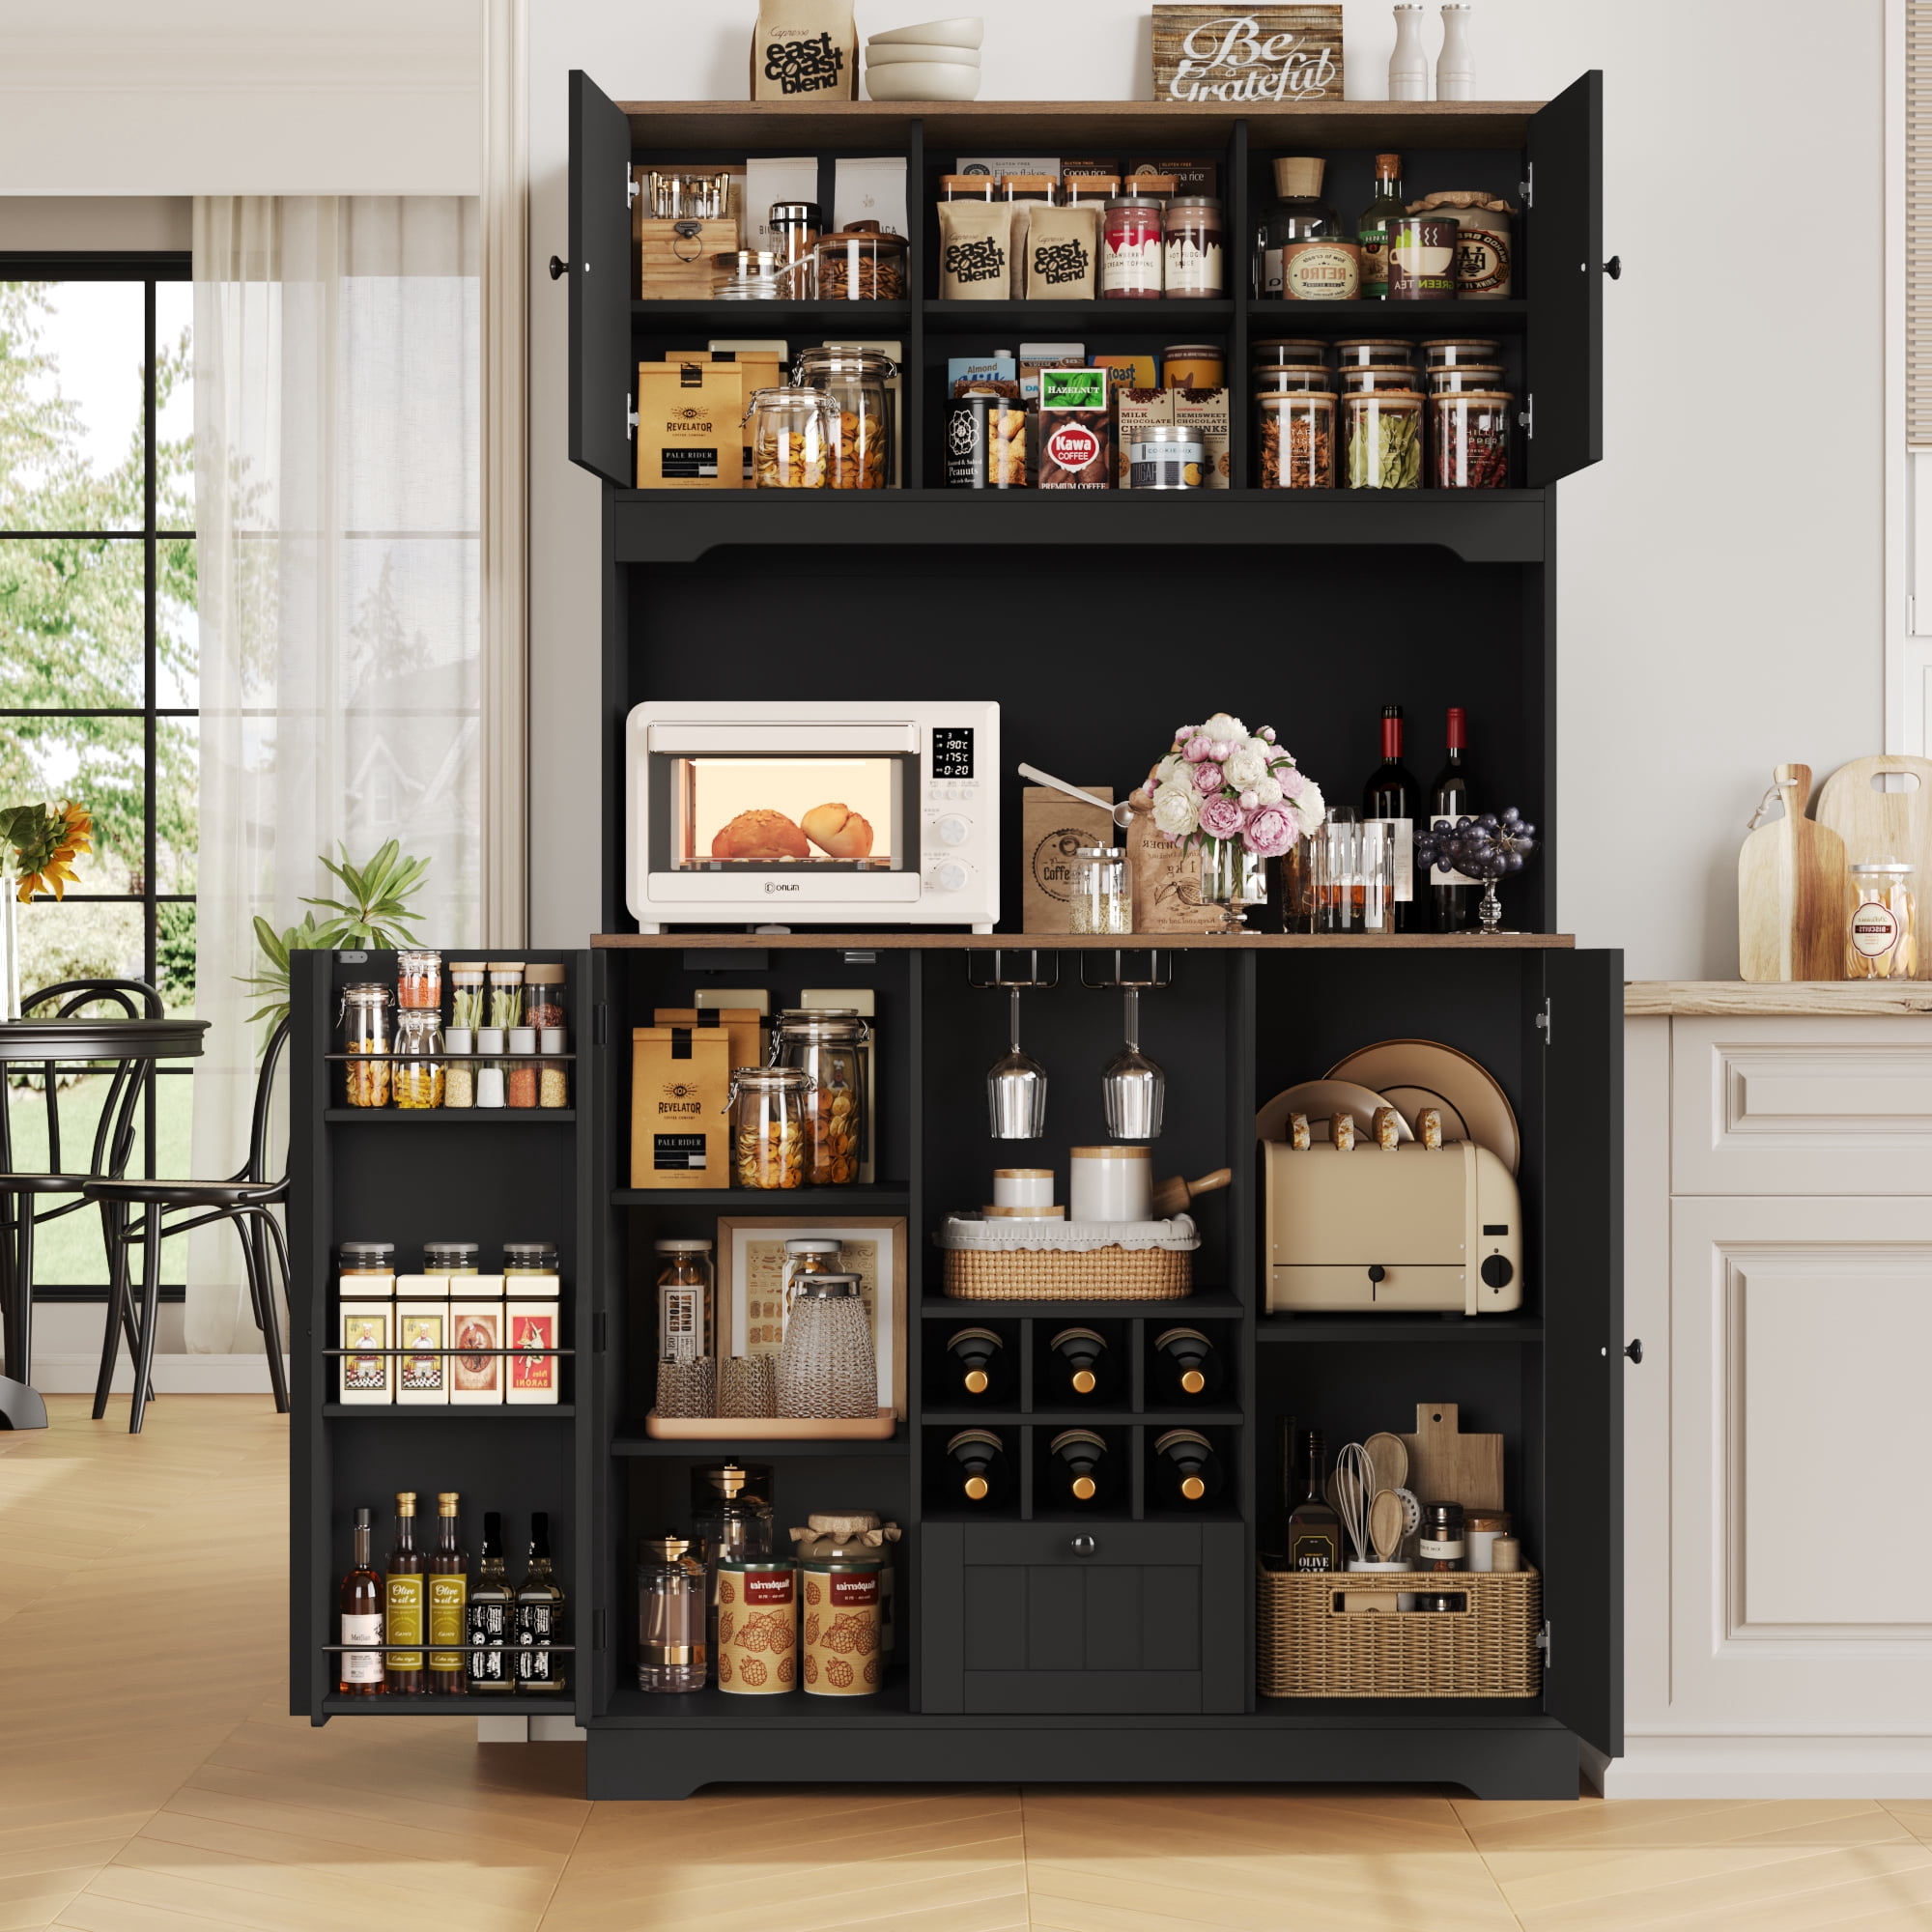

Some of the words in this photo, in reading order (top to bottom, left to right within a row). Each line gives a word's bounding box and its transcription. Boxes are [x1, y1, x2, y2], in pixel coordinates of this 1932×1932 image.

[766, 32, 833, 63] east
[1182, 14, 1305, 67] Be
[764, 46, 843, 80] coast
[1166, 47, 1336, 100] Grateful
[781, 69, 838, 94] blend
[1189, 171, 1205, 181] rice
[947, 237, 996, 259] east
[1035, 238, 1081, 261] east
[946, 248, 1006, 273] coast
[1034, 249, 1089, 274] coast
[957, 263, 1001, 283] blend
[1045, 266, 1085, 285] blend
[967, 362, 998, 374] Almond
[667, 422, 713, 433] REVELATOR
[1056, 436, 1092, 451] Kawa
[1058, 452, 1089, 461] COFFEE
[949, 467, 979, 477] Peanuts
[944, 765, 969, 776] 0:20
[659, 1101, 701, 1115] REVELATOR
[658, 1138, 675, 1147] PALE
[678, 1138, 701, 1147] RIDER
[1298, 1556, 1329, 1567] OLIVE
[392, 1584, 415, 1596] Olive
[435, 1584, 458, 1596] Olive
